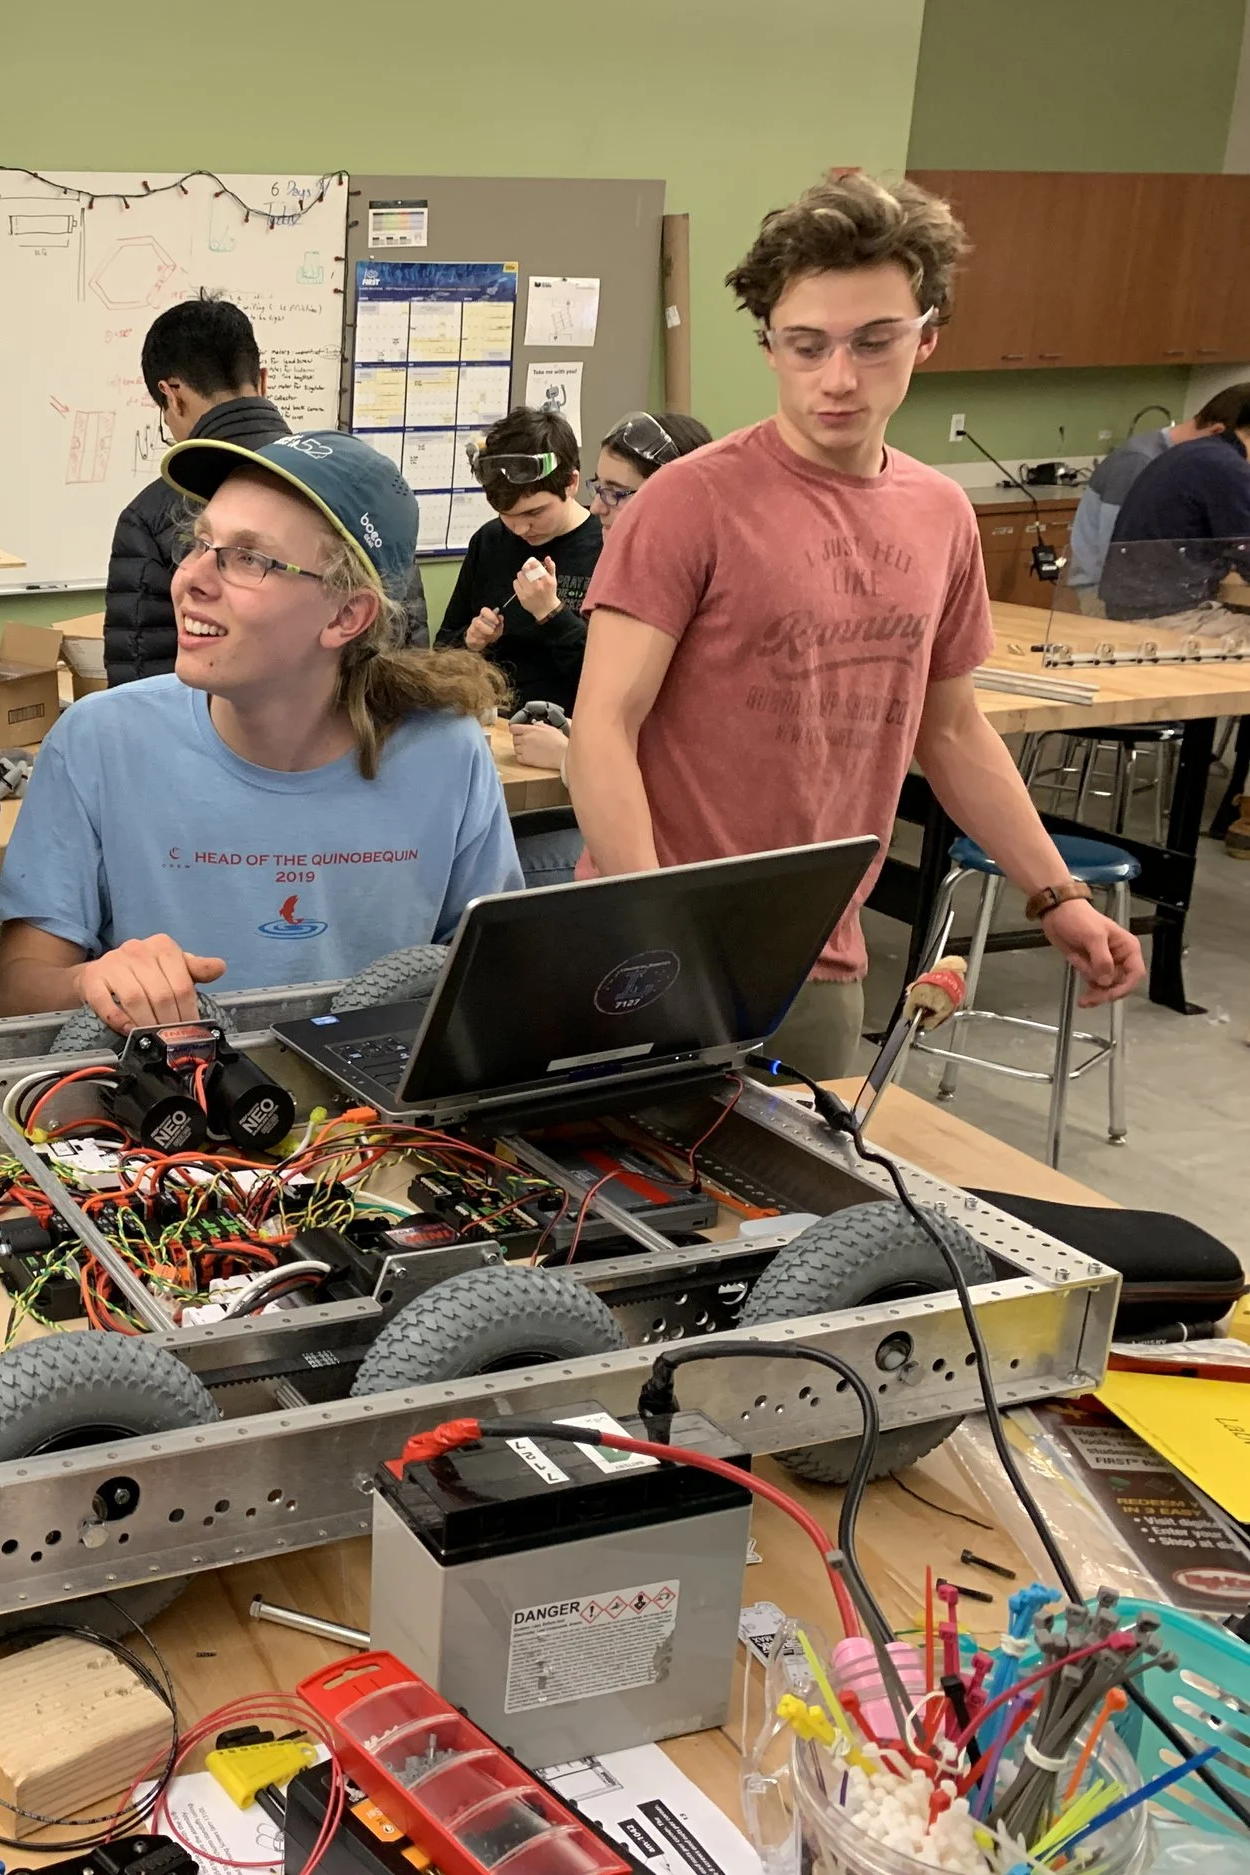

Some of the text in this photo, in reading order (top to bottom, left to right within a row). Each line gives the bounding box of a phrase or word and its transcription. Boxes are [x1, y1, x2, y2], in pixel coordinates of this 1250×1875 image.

[271, 182, 280, 196] 6
[822, 537, 861, 562] JUST
[873, 540, 913, 574] FELT
[833, 566, 883, 597] LIKE
[756, 605, 931, 662] Running
[195, 849, 419, 866] HEAD OF THE QUINOBEQUIN
[275, 871, 315, 883] 2019
[615, 998, 640, 1009] 7127
[241, 1098, 274, 1133] NEO
[153, 1110, 186, 1147] NEO
[514, 1441, 560, 1482] 7127
[1117, 1498, 1185, 1507] REDEEM
[1143, 1516, 1177, 1526] Visit
[1151, 1526, 1222, 1539] Enter your
[1158, 1537, 1196, 1548] Shop
[1199, 1540, 1215, 1548] at
[514, 1601, 580, 1625] DANGER
[653, 1815, 664, 1827] The
[626, 1824, 656, 1853] am-1042
[694, 1850, 712, 1868] screws
